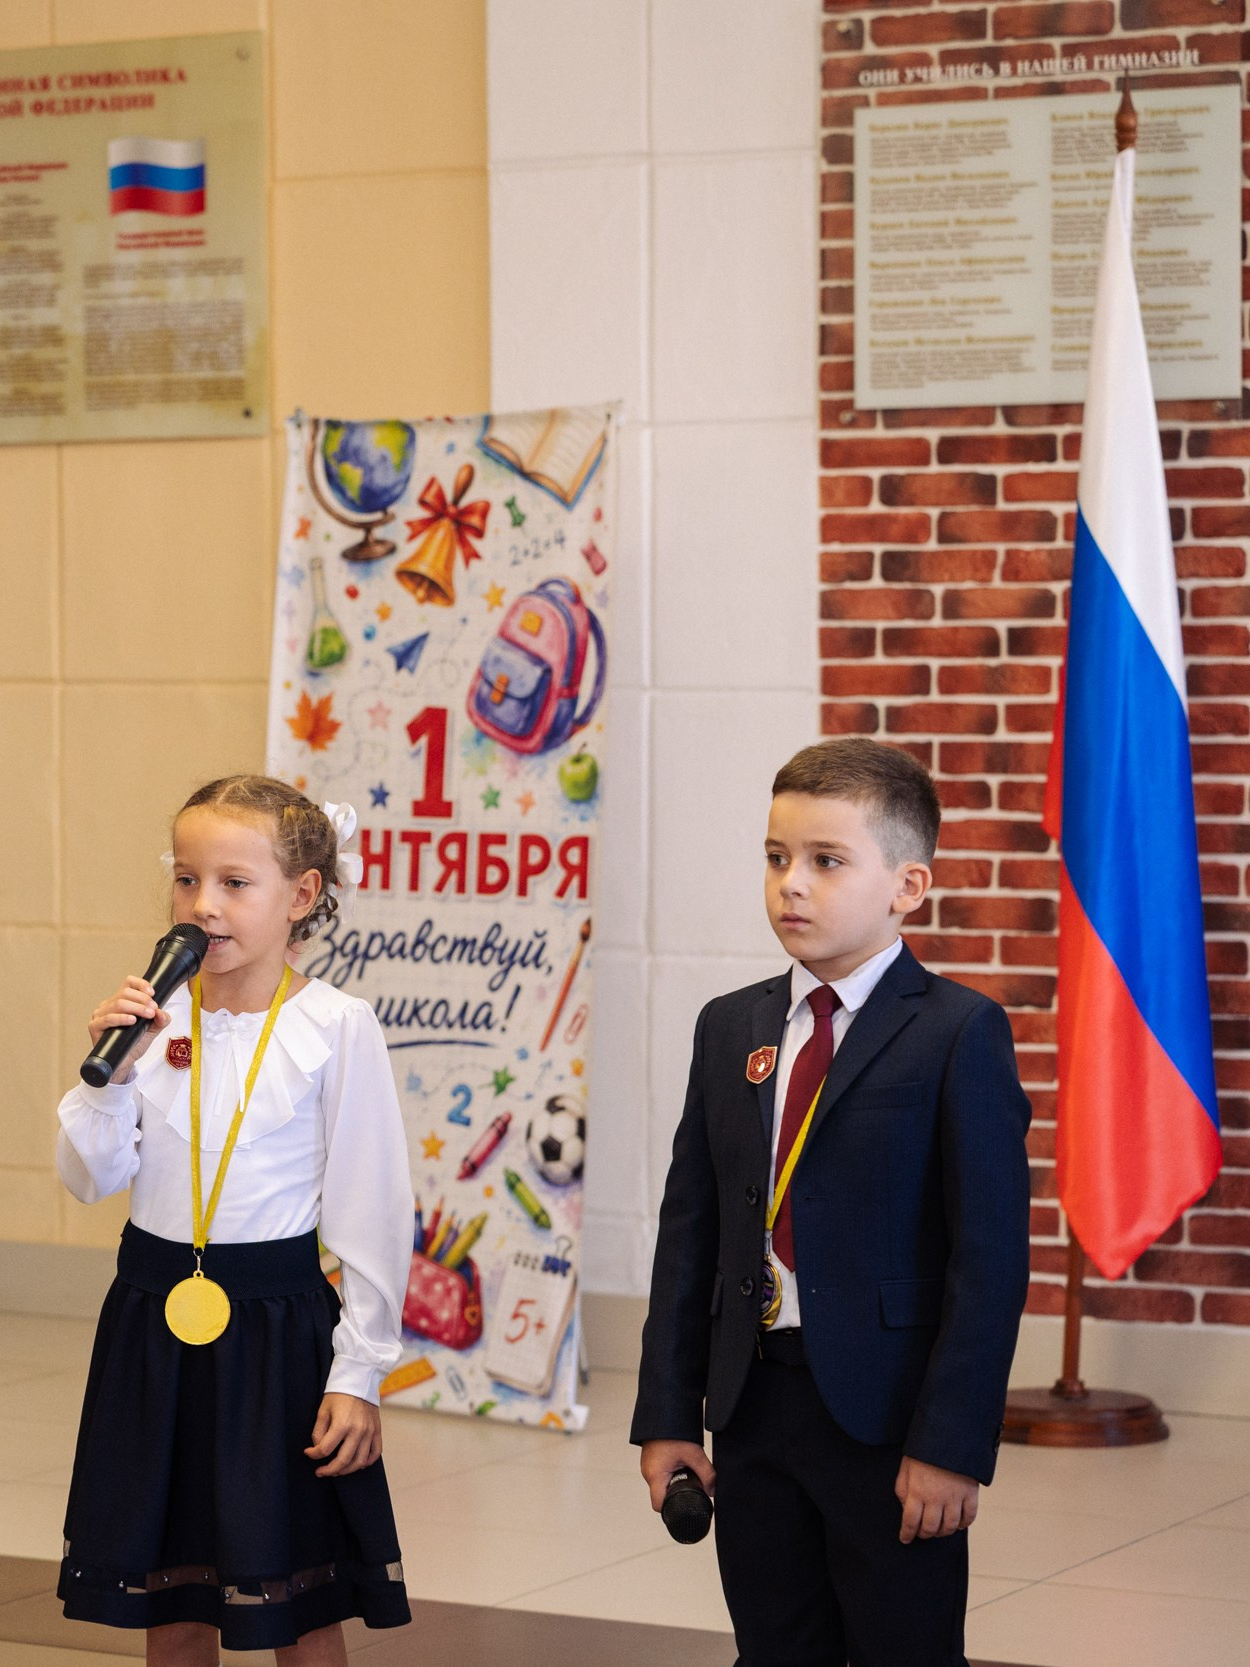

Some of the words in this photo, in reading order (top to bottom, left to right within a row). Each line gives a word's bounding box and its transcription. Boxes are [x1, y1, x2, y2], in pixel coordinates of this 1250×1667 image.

[57, 67, 187, 91] СИМВОЛИКА
[858, 69, 899, 86] ОНИ
[905, 62, 994, 84] УЧИЛИСЬ
[999, 60, 1012, 77] В
[1017, 53, 1087, 77] НАШЕЙ
[1094, 49, 1200, 72] ГИМНАЗИИ
[30, 92, 155, 116] ФЕДЕРАЦИИ
[406, 706, 453, 818] 1
[336, 828, 589, 900] НТЯБРЯ
[305, 915, 554, 992] Здравствуй,
[375, 985, 521, 1033] школа!
[447, 1083, 473, 1127] 2
[504, 1298, 546, 1344] 5+
